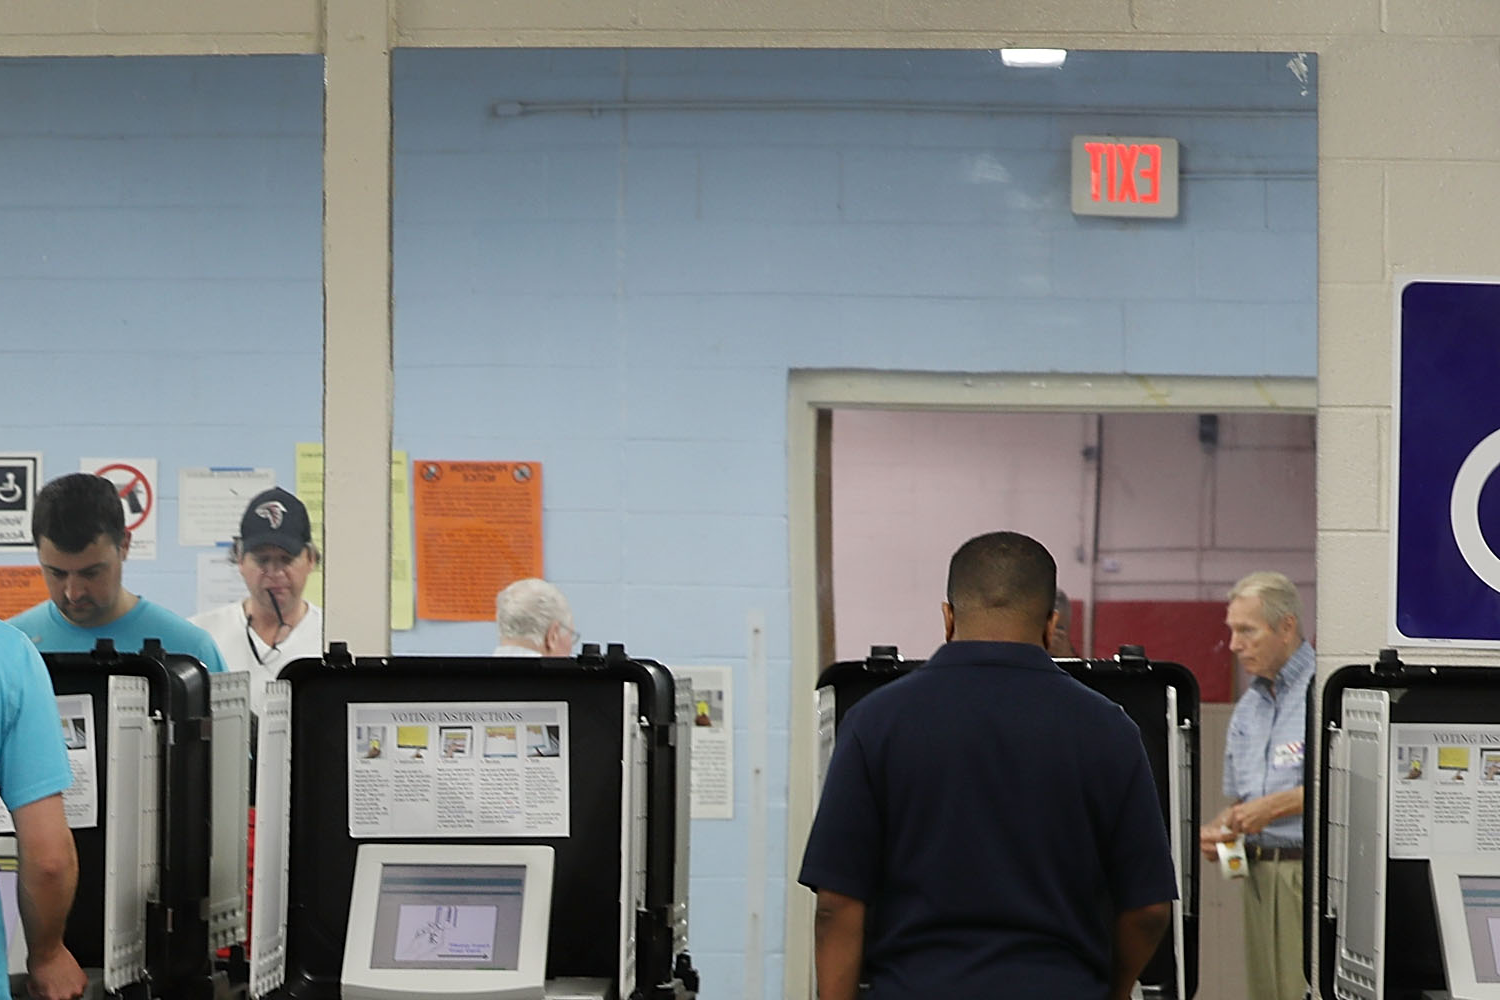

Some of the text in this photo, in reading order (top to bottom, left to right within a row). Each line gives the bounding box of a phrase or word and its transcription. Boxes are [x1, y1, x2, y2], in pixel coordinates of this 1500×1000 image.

[391, 711, 524, 722] VOTING INSTRUCTIONS
[1432, 733, 1477, 744] VOTING
